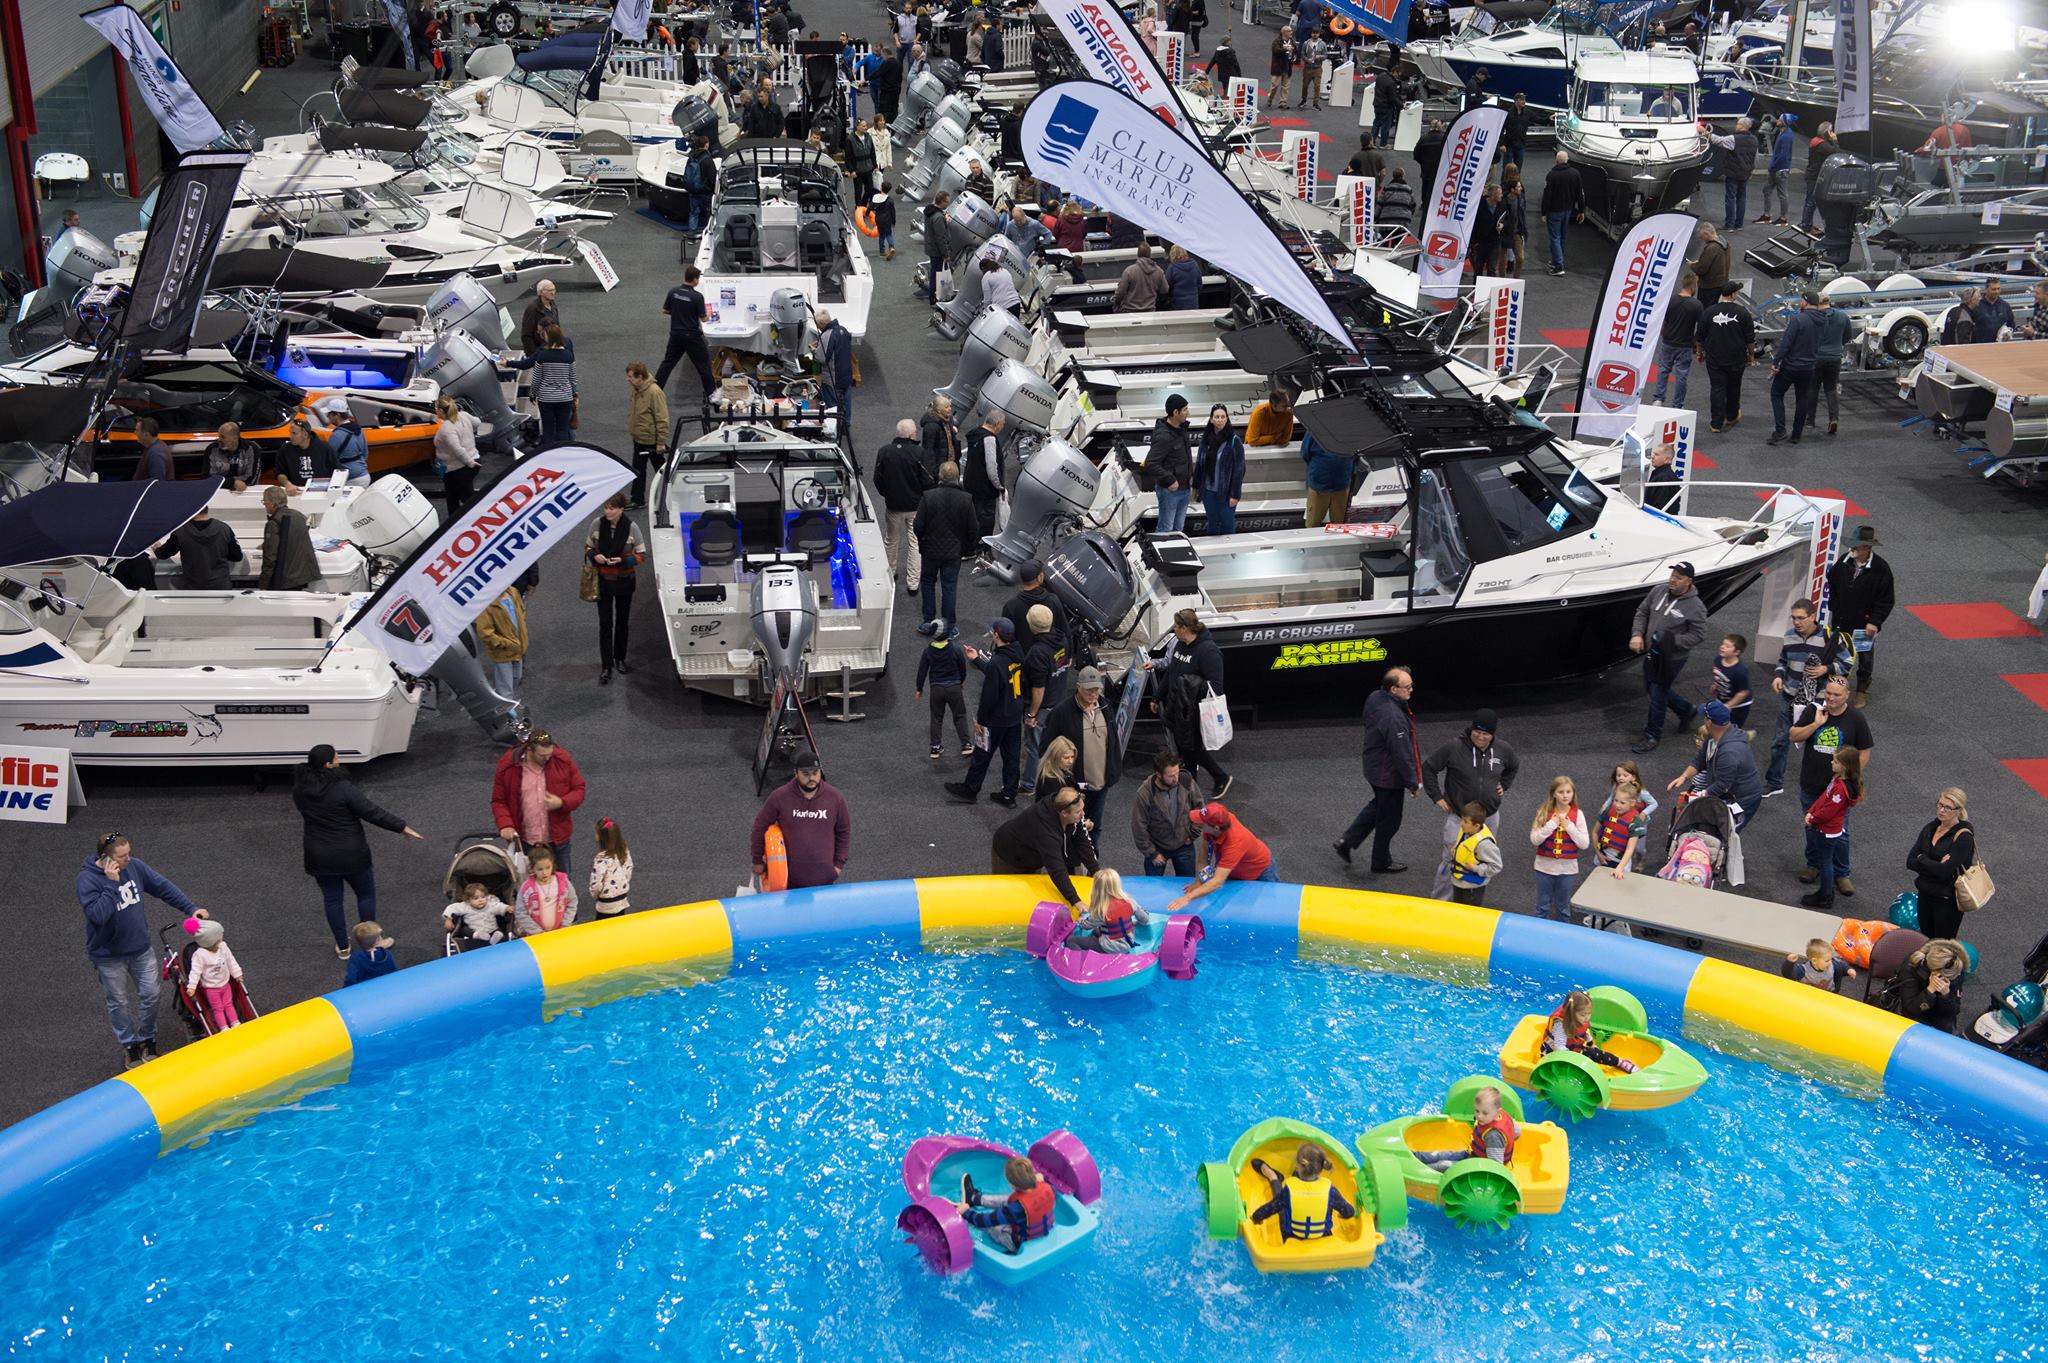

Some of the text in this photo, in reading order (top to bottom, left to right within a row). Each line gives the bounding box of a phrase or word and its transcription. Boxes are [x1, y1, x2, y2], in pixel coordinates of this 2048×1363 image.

[142, 58, 164, 86] HAINES
[1112, 130, 1194, 184] CLUB
[1297, 138, 1308, 200] acific
[1090, 145, 1195, 210] MARINE
[1437, 125, 1473, 219] HONDA
[1453, 128, 1489, 221] MARINE
[1083, 164, 1186, 224] INSURANCE
[1354, 181, 1364, 245] cific
[1437, 237, 1453, 251] 7
[73, 249, 112, 270] HONDA
[1005, 257, 1026, 279] HONDA
[1086, 296, 1107, 304] BAR
[1608, 235, 1655, 346] HONDA
[1629, 238, 1674, 349] MARINE
[431, 297, 460, 319] HONDA
[1003, 331, 1030, 352] HONDA
[1494, 288, 1509, 371] acific
[423, 357, 452, 378] HONDA
[1609, 368, 1628, 385] 7
[1020, 387, 1053, 409] HONDA
[1605, 384, 1625, 392] YEAR
[1675, 425, 1689, 478] RINE
[1060, 465, 1095, 492] HONDA
[395, 484, 413, 503] 225
[351, 516, 375, 529] HONDA
[422, 467, 565, 586] HONDA
[1235, 519, 1290, 529] RUSHER
[448, 483, 587, 606] MARINE
[1062, 559, 1088, 585] YAMAHA
[1811, 512, 1831, 618] cific
[768, 579, 793, 588] 135
[392, 607, 421, 634] 7
[1242, 624, 1355, 642] BAR CRUSHER
[1271, 649, 1387, 669] MARINE
[1282, 638, 1380, 657] PACIFIC
[216, 705, 308, 713] SEAFARER
